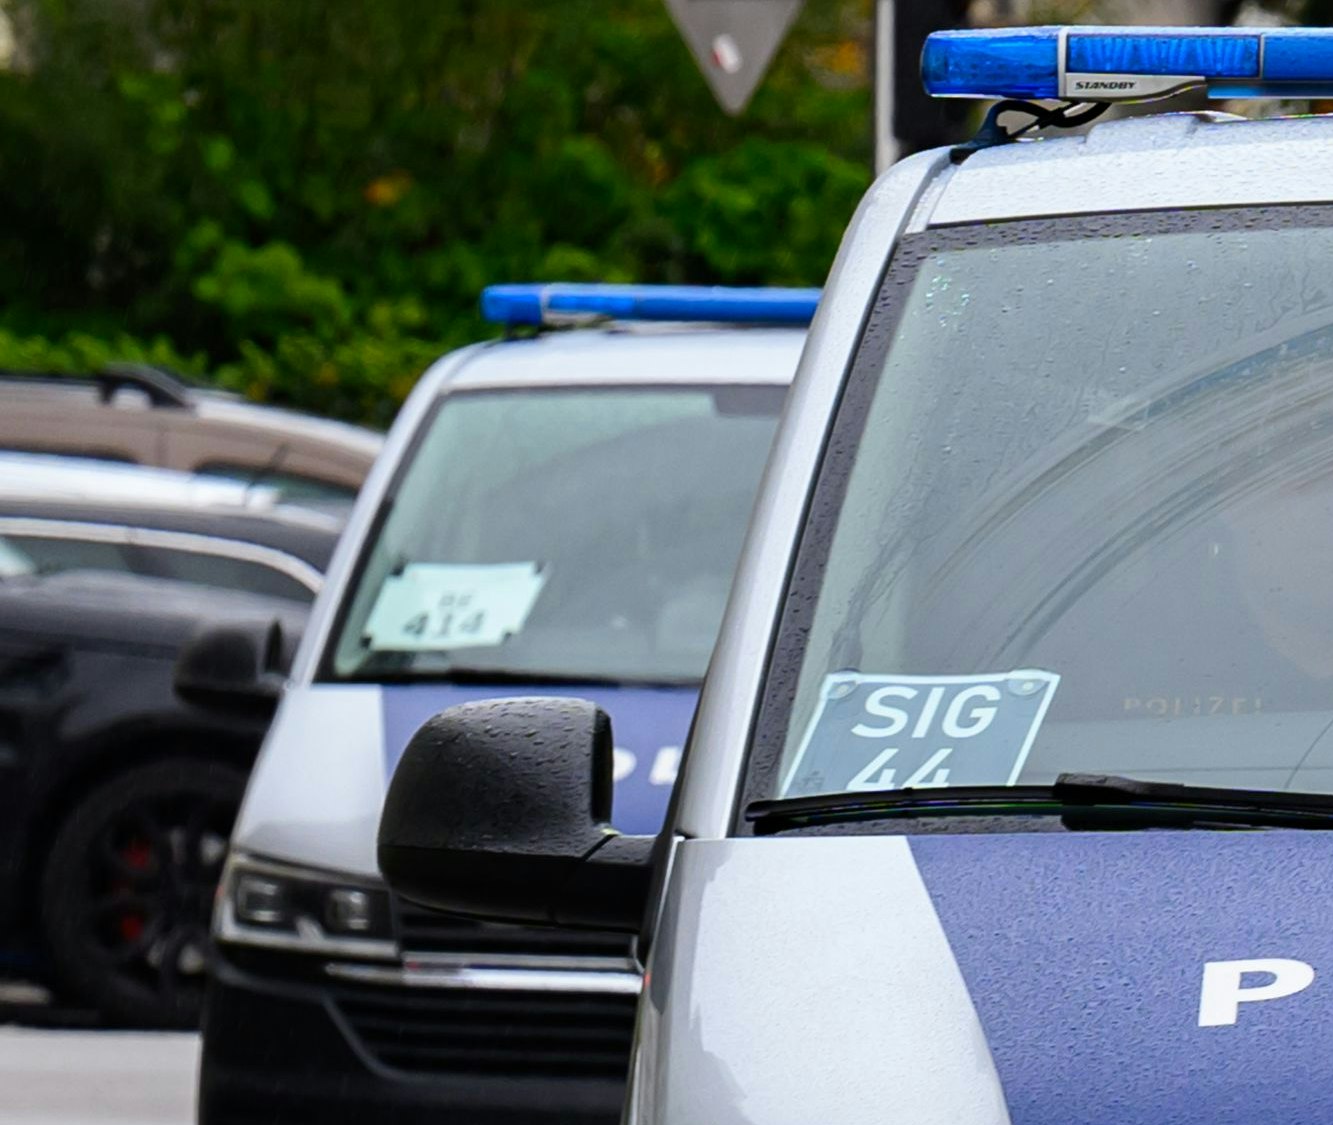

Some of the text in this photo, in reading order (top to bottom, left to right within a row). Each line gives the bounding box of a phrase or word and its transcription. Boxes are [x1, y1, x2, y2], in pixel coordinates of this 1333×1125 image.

[1075, 81, 1136, 90] STANDBY
[851, 684, 1001, 739] SIG
[846, 747, 953, 791] 44
